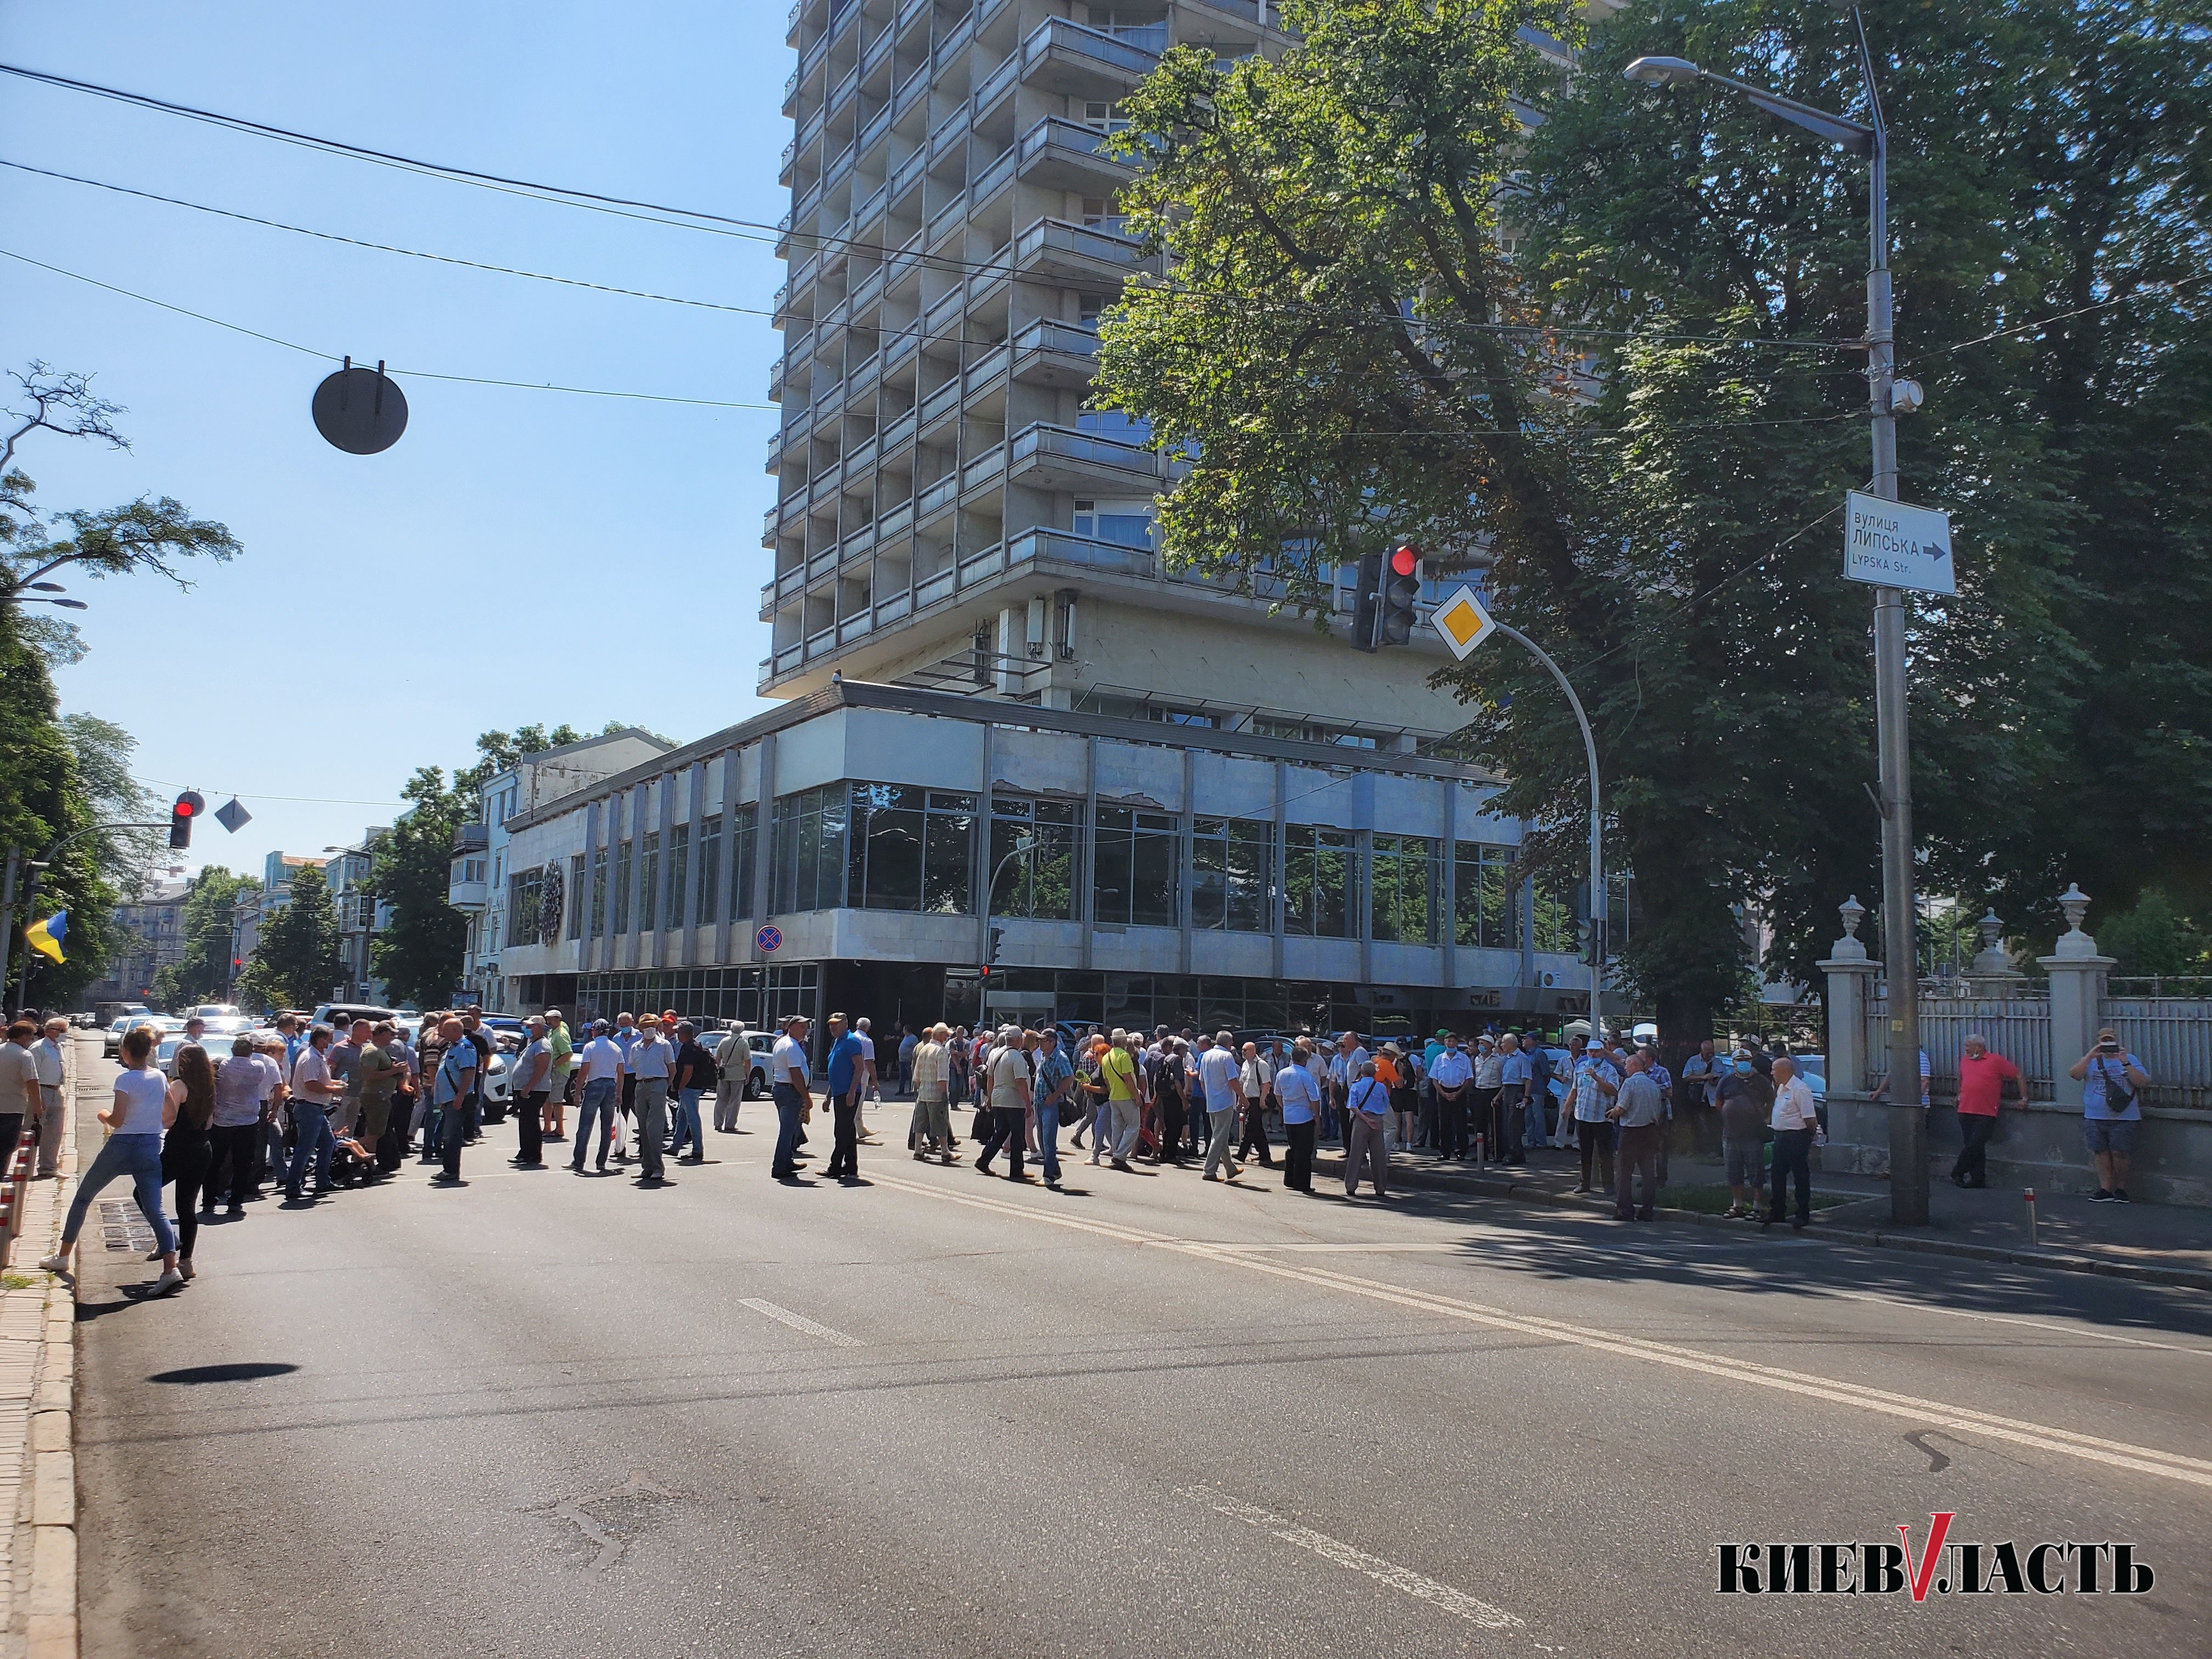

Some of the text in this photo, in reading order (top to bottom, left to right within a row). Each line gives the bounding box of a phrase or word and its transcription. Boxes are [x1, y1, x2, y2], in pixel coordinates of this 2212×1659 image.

[1853, 529, 1919, 556] ЛИПСЬКА
[1852, 554, 1911, 574] LYPSKA Str.
